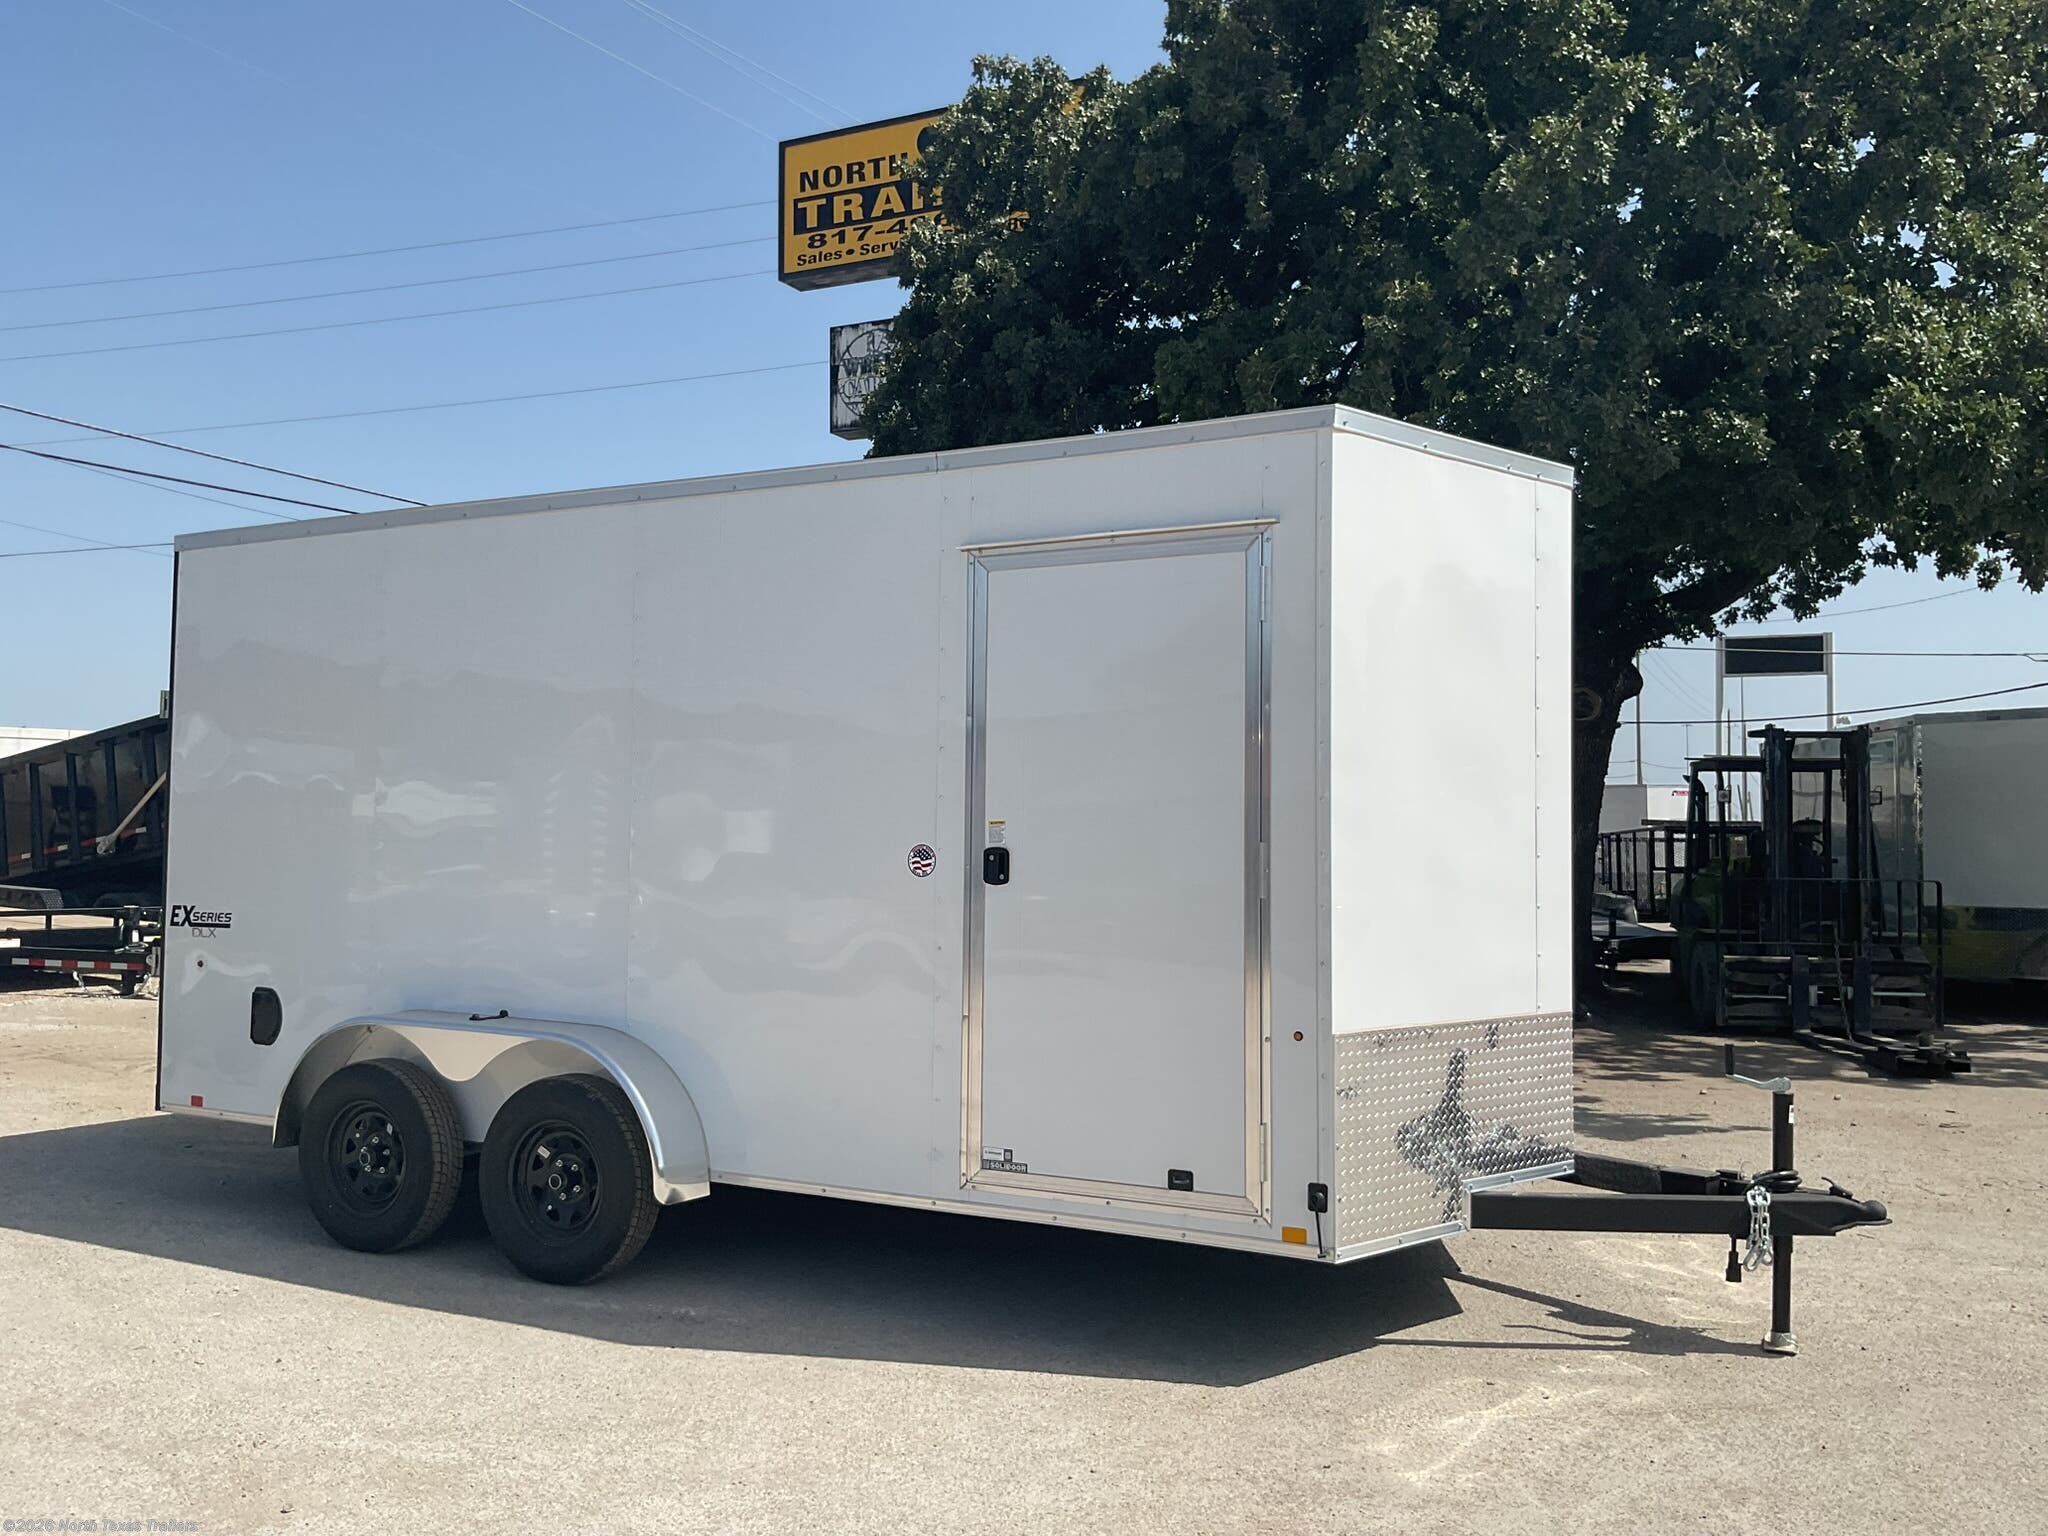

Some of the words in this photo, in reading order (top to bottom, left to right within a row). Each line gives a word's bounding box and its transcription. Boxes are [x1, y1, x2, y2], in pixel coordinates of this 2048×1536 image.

[799, 152, 909, 193] NORTH
[796, 250, 843, 266] Sales
[859, 240, 900, 256] Serv
[192, 927, 217, 938] DLX
